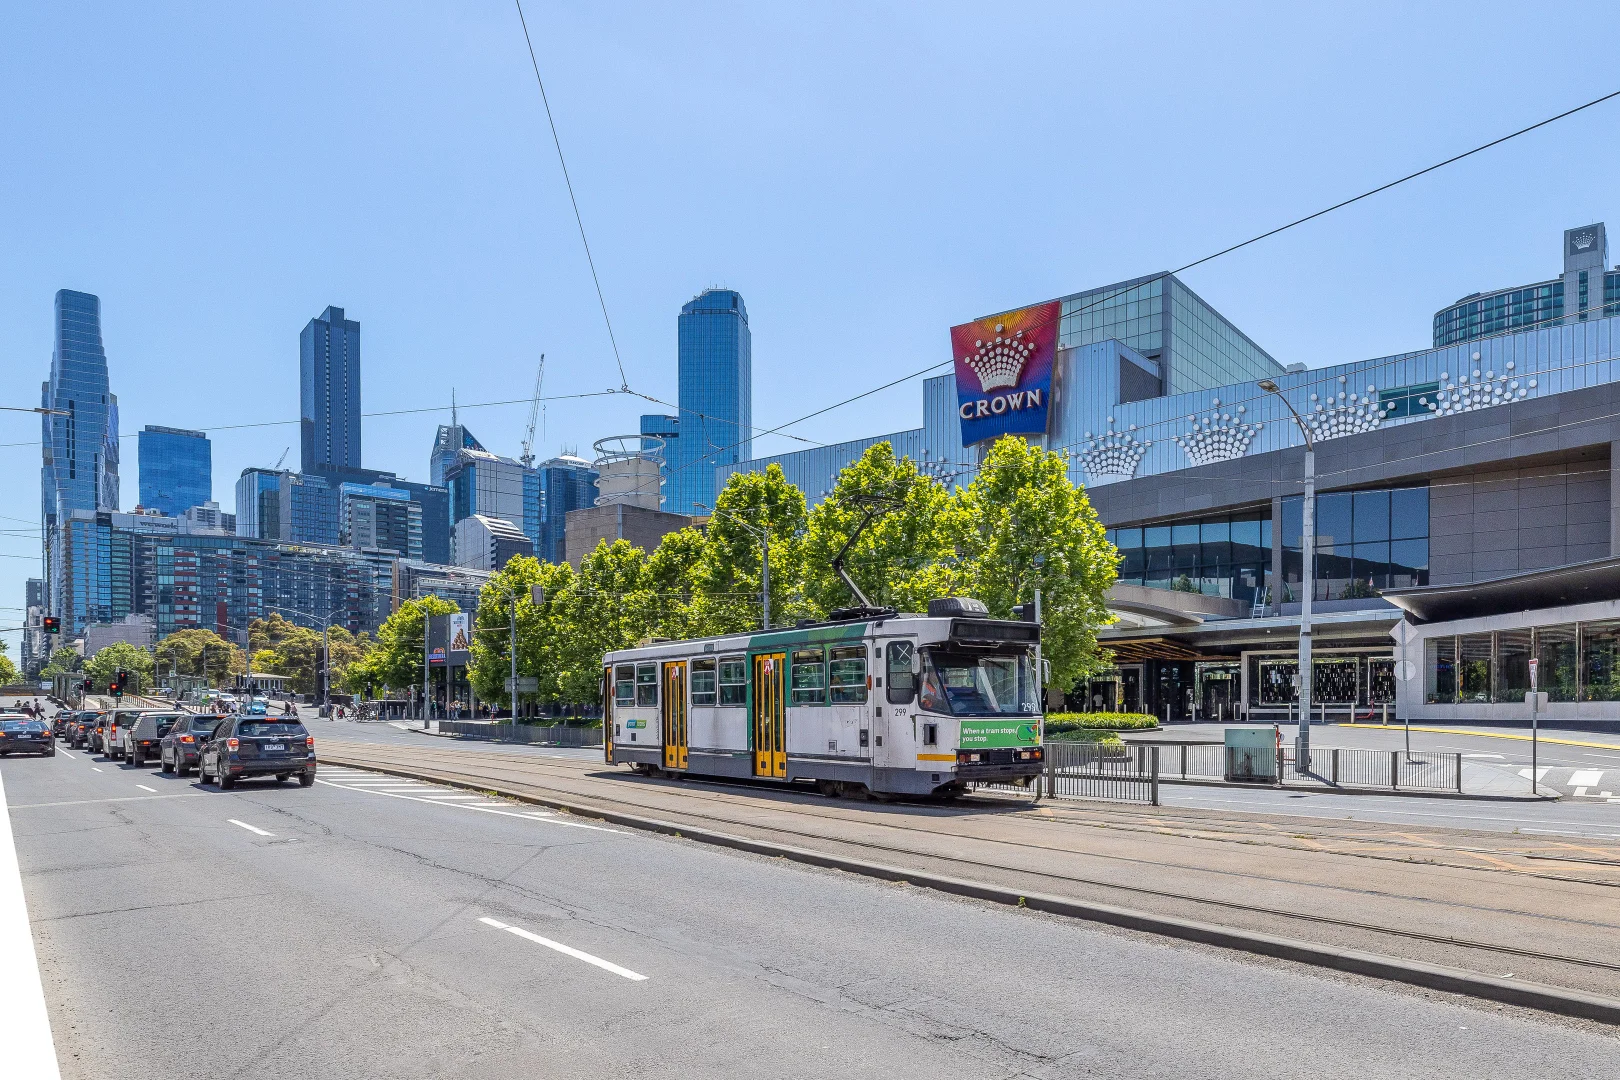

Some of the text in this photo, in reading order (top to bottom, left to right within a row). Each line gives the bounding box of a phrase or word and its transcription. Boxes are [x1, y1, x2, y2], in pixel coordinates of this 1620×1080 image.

[960, 389, 1042, 420] CROWN
[895, 707, 907, 717] 299
[974, 735, 988, 743] stop.
